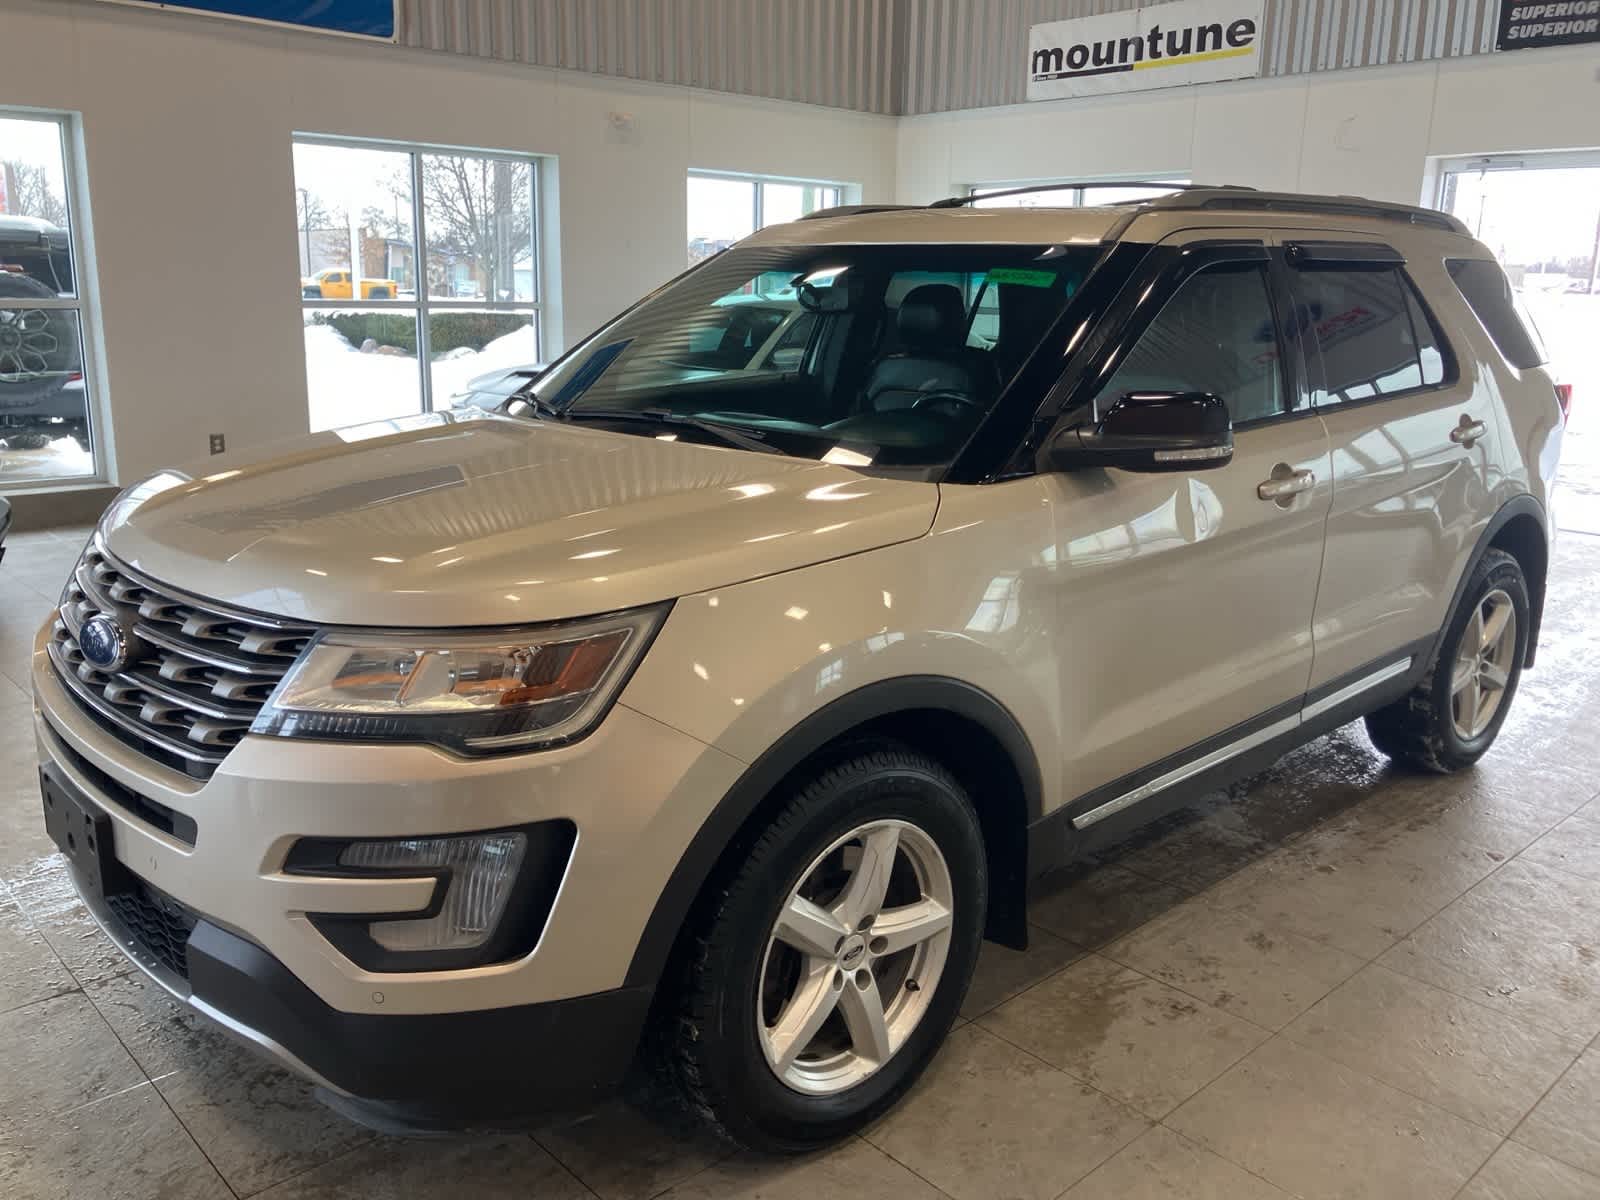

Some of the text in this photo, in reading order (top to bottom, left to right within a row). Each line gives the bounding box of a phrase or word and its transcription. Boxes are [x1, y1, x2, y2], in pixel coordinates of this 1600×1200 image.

[1510, 1, 1600, 21] SUPERIOR
[1507, 19, 1599, 39] SUPERIOR
[1032, 18, 1256, 74] mountune
